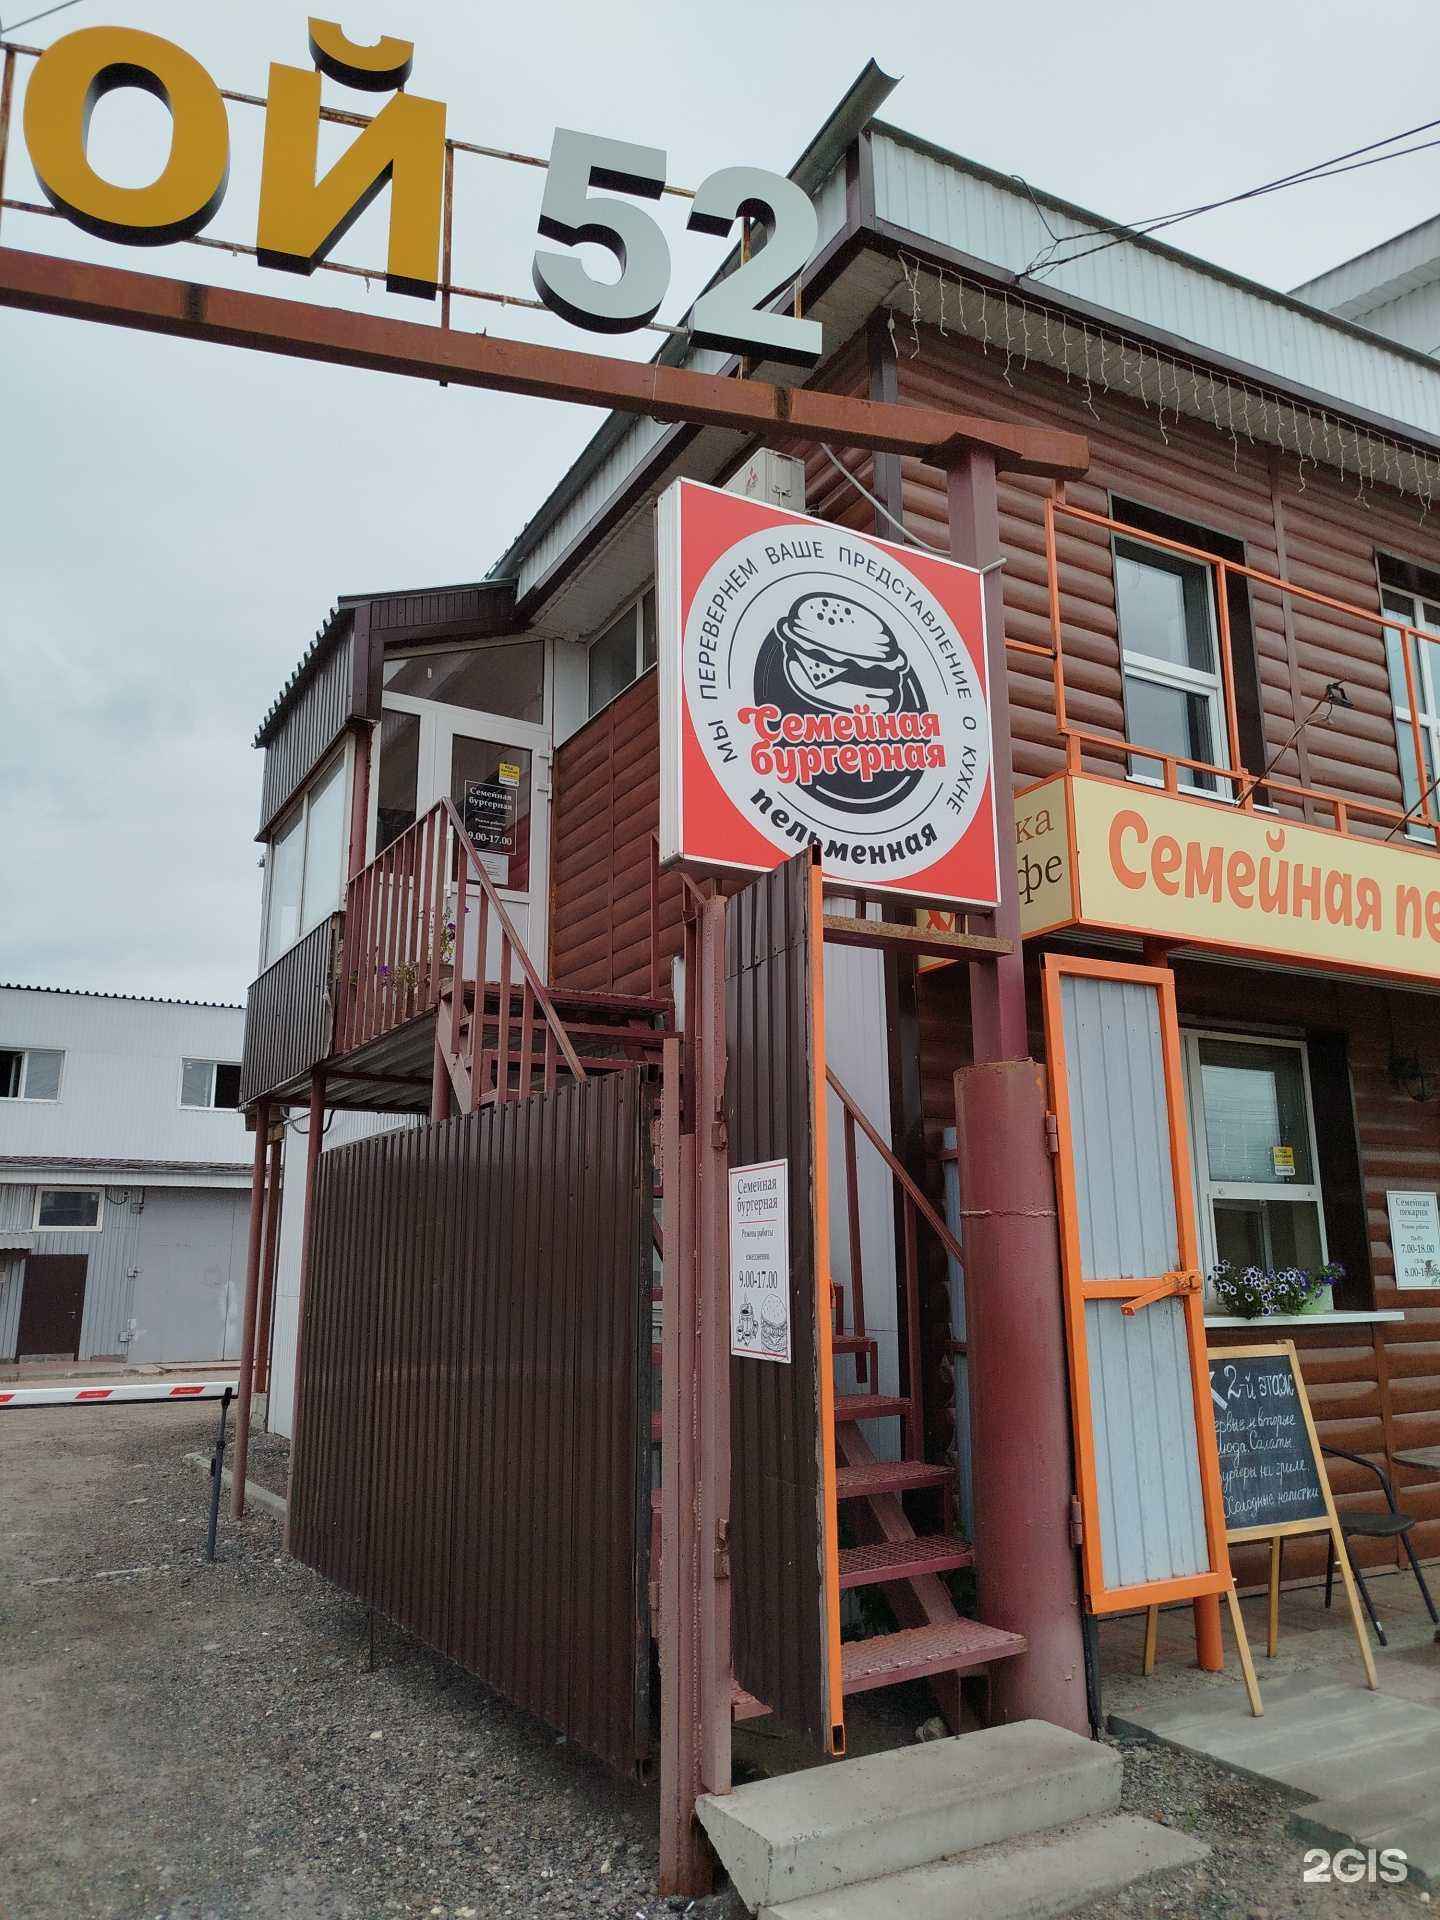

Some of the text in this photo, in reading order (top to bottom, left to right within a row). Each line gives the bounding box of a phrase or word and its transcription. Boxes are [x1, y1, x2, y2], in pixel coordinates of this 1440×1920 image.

[23, 17, 824, 367] ОЙ 52
[698, 540, 977, 816] МЫ ПЕРЕВЕРНЕМ ВАШЕ ПРЕДСТАВЛЕНИЕ О КУХНЕ
[737, 704, 941, 743] Семейная
[749, 738, 946, 785] бургерная
[469, 796, 513, 812] бургерная
[470, 786, 513, 802] Семейная
[468, 831, 512, 846] 9.00-17.00
[1108, 808, 1440, 944] Семейная пе
[737, 1177, 777, 1195] Семейная
[737, 1196, 778, 1217] бургерная
[738, 1270, 778, 1289] 9.00-17.00
[1223, 1364, 1294, 1400] 2-й этаж
